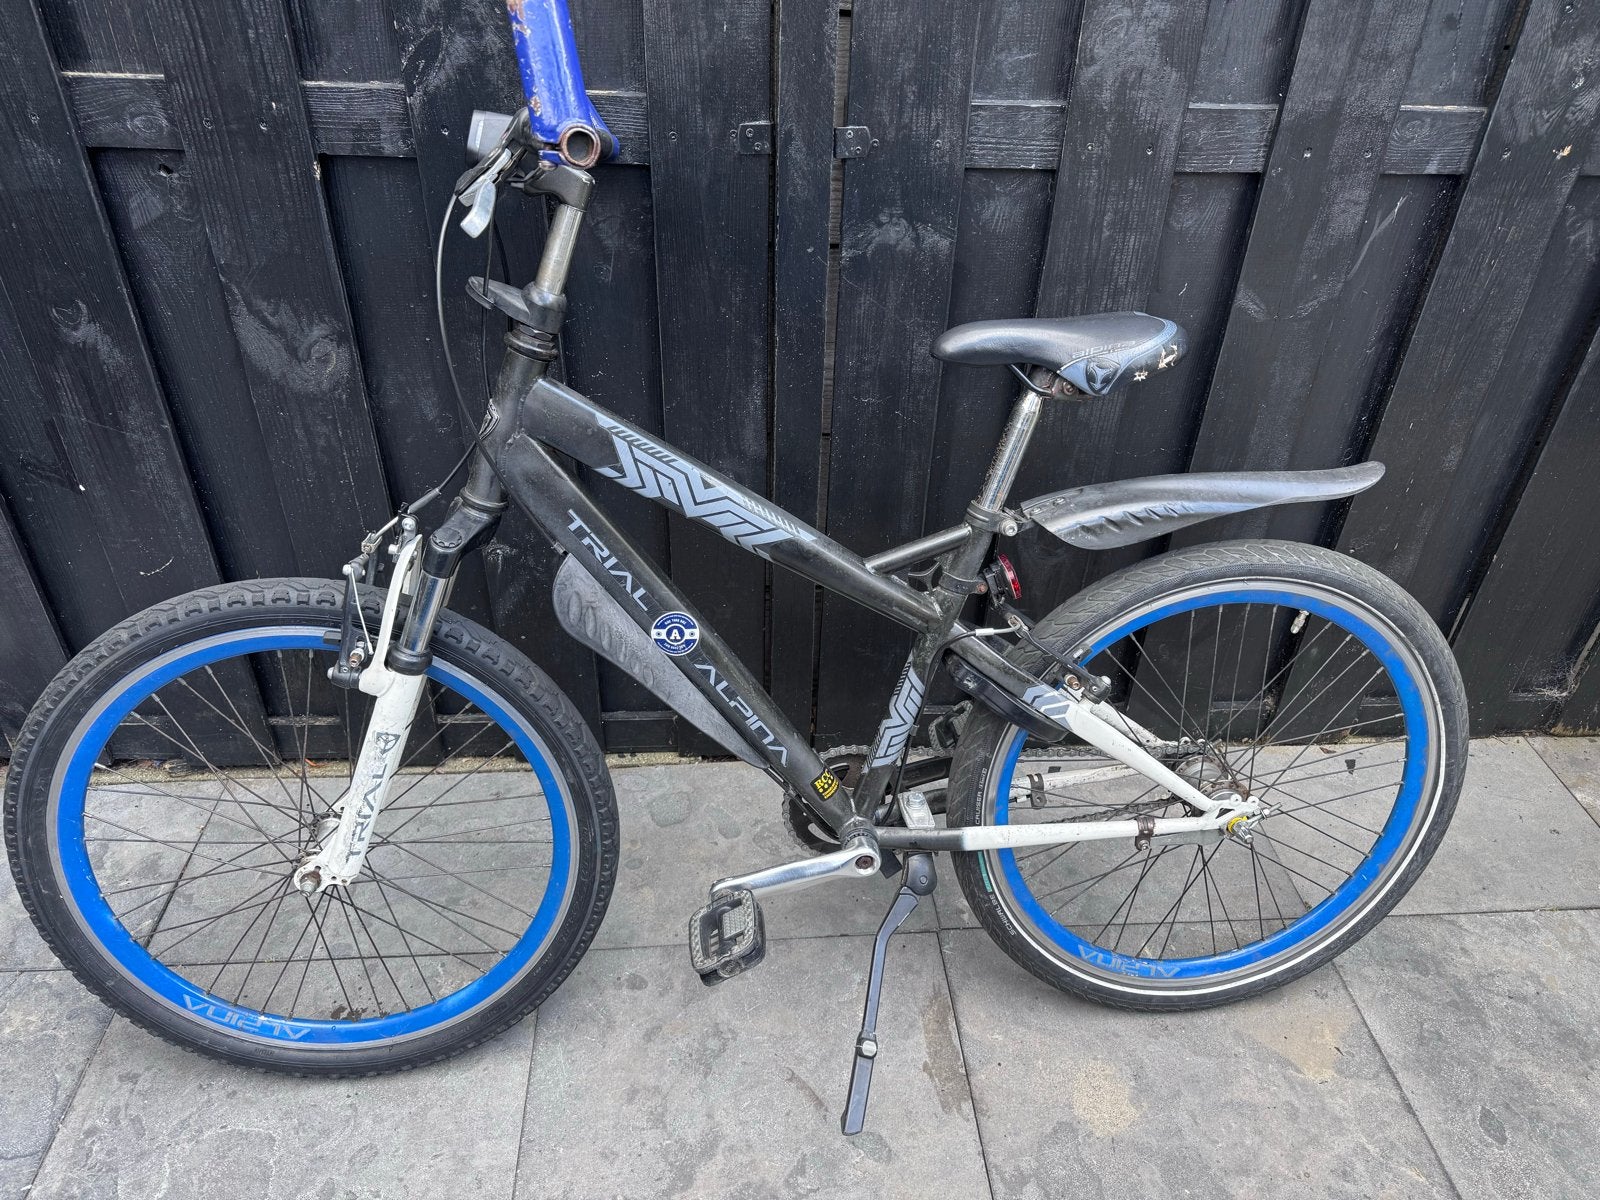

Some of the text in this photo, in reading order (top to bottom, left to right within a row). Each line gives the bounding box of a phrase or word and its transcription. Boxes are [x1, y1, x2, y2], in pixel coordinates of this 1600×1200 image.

[566, 508, 649, 612] TRIAL
[670, 629, 681, 640] A
[694, 662, 789, 768] ALPINA
[345, 763, 388, 864] TRIAL
[988, 894, 1017, 936] SCHWALBE
[182, 993, 312, 1040] ALPINA
